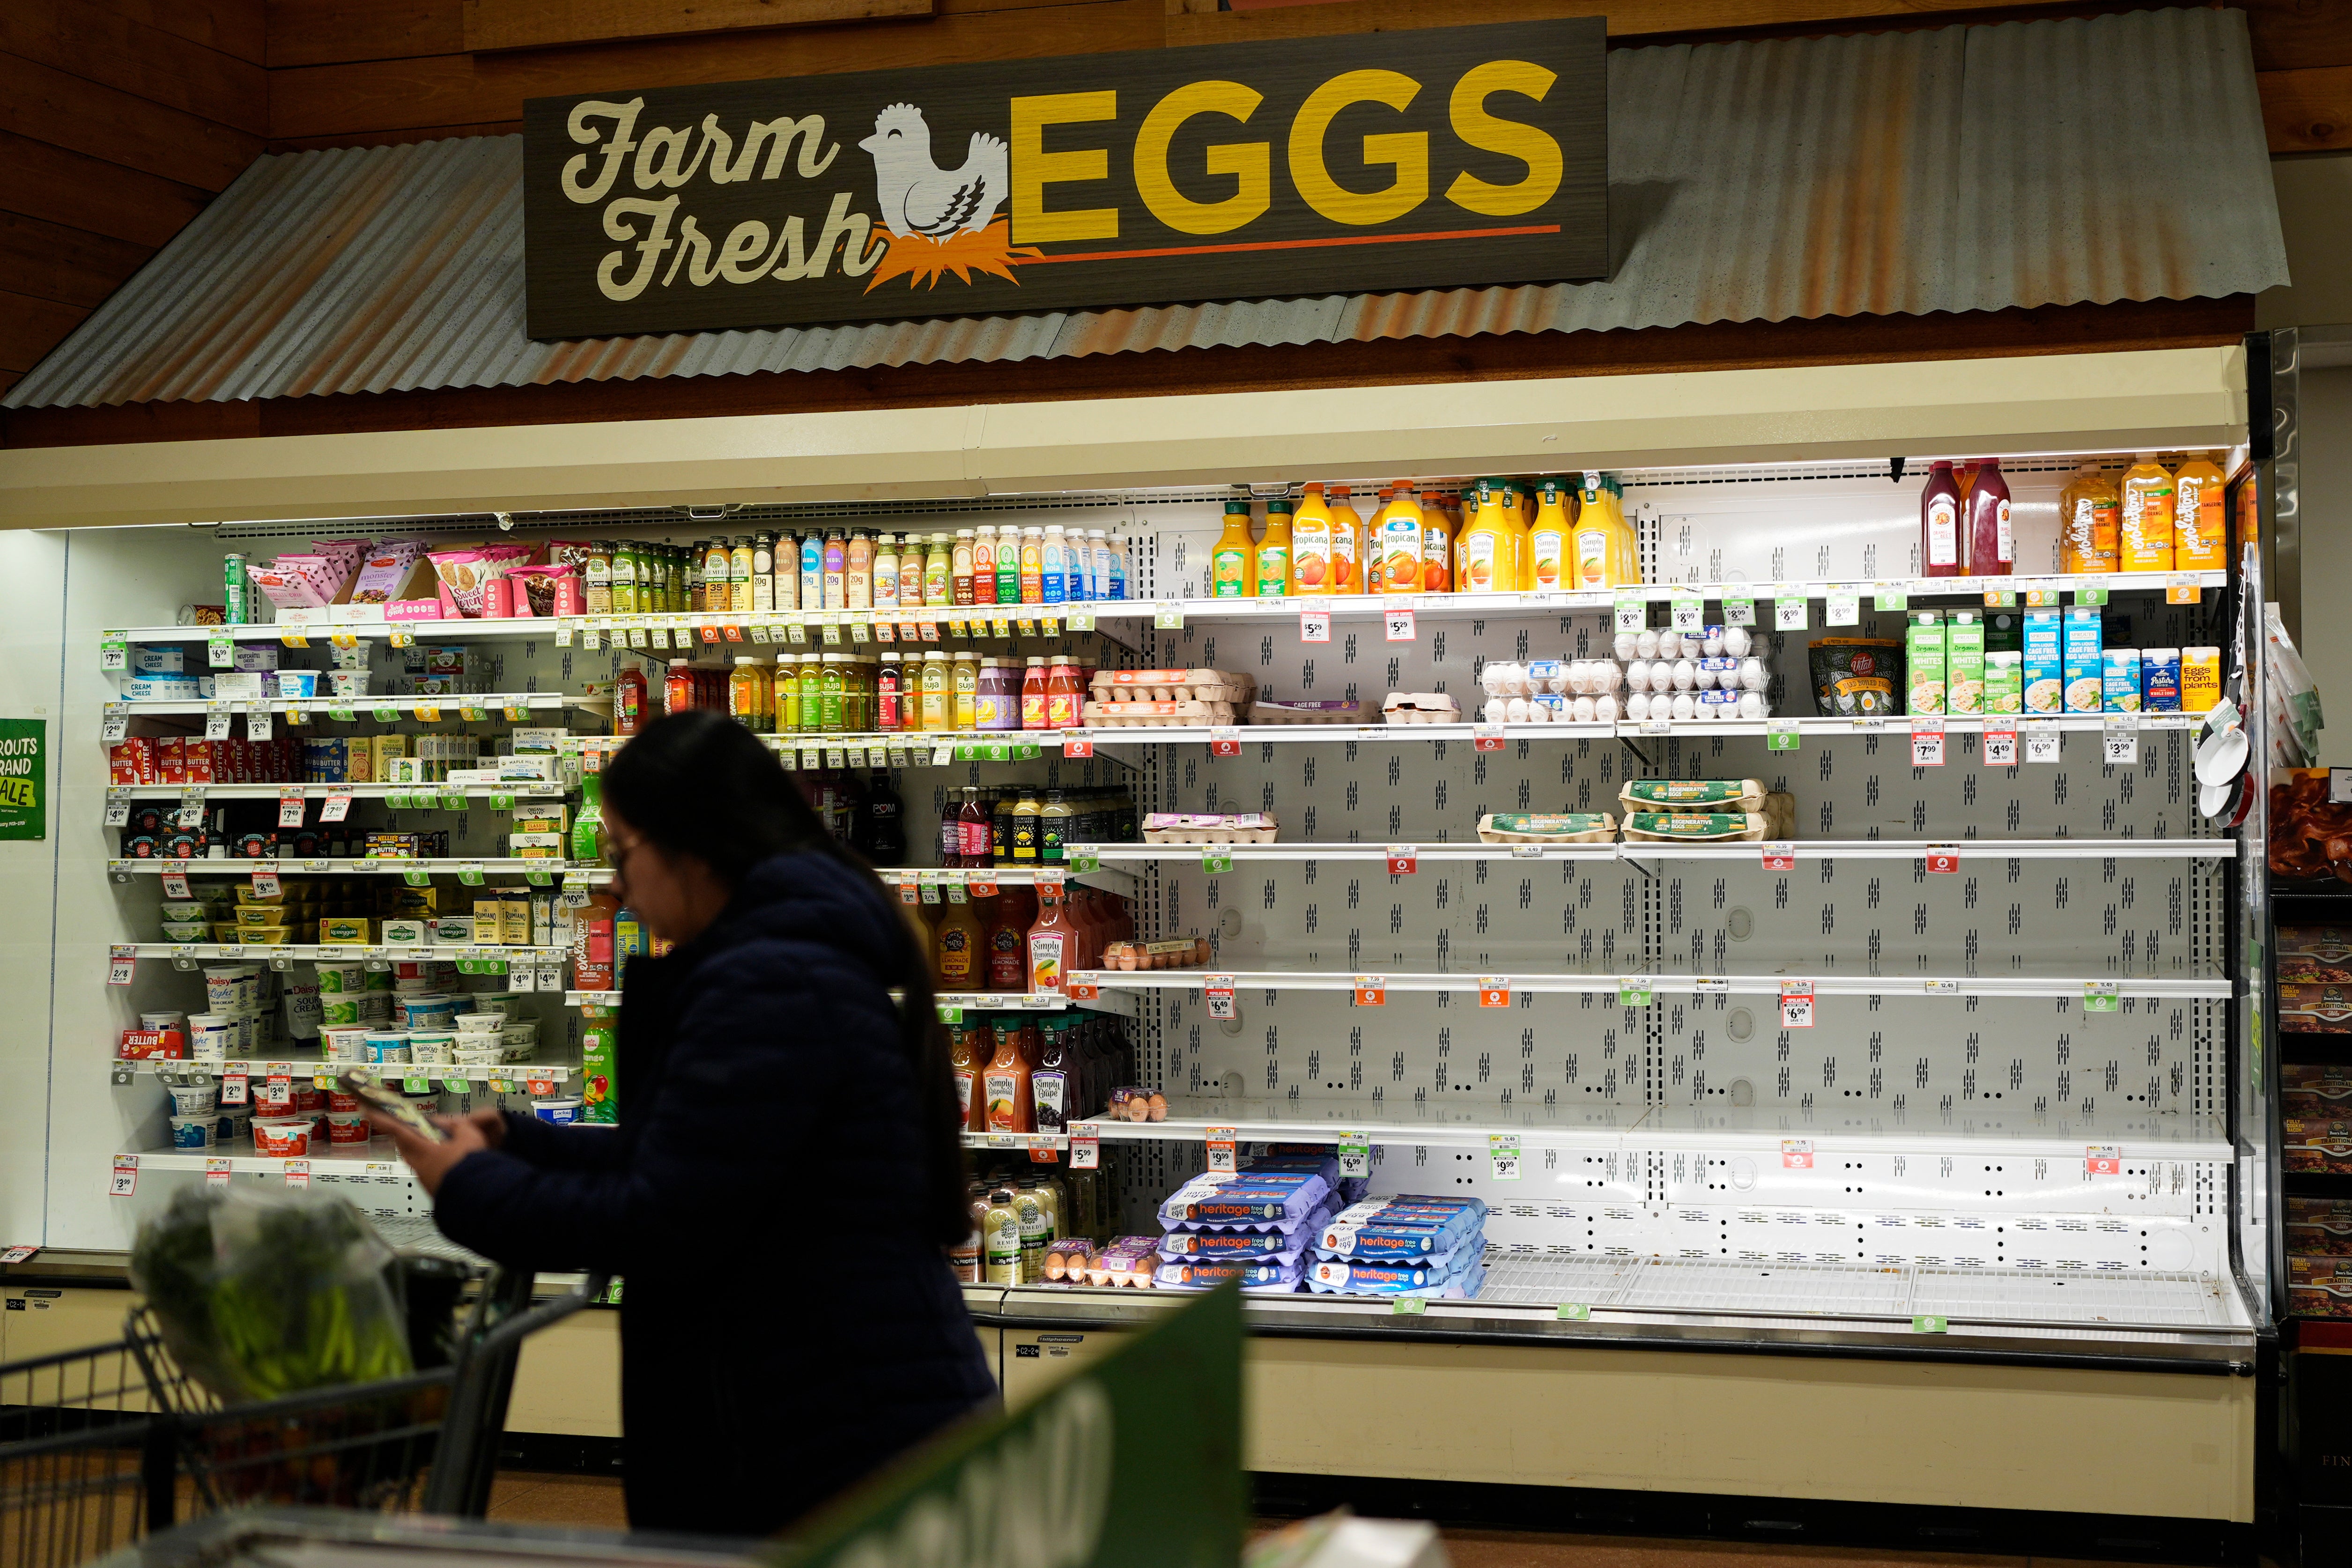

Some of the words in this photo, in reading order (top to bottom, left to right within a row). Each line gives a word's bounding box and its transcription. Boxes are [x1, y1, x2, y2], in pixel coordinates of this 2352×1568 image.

[561, 97, 840, 204] Farm
[1010, 59, 1563, 244] EGGS
[597, 191, 887, 301] Fresh
[2123, 489, 2145, 549] evolution
[1293, 534, 1328, 545] Tropicana
[1385, 533, 1419, 545] Tropicana
[1537, 539, 1558, 549] Simply
[1582, 538, 1603, 548] Simply
[360, 572, 394, 581] monster
[754, 577, 767, 585] 20g
[827, 576, 838, 585] 20g
[851, 576, 862, 584] 20g
[454, 586, 481, 599] Sweet
[1851, 657, 1872, 672] Vital
[1831, 671, 1853, 684] PASTURE
[1876, 671, 1895, 681] RAISED
[2151, 676, 2174, 686] Pasture
[824, 682, 840, 690] suja
[2184, 680, 2218, 689] plants
[0, 779, 29, 806] ALE
[1033, 940, 1059, 952] Simply
[1033, 951, 1060, 960] Lemonade
[208, 977, 231, 986] Daisy
[209, 989, 234, 999] Light
[127, 1035, 158, 1044] BUTTER
[417, 1045, 437, 1054] Nancy's
[988, 1078, 1013, 1089] Simply
[1036, 1080, 1060, 1090] Simply
[989, 1087, 1013, 1096] Grapefruit
[1039, 1088, 1058, 1099] Grape
[1172, 1209, 1183, 1218] egg
[1199, 1204, 1250, 1217] heritage
[1200, 1236, 1250, 1249] heritage
[1360, 1237, 1404, 1249] heritage
[1353, 1269, 1397, 1281] heritage
